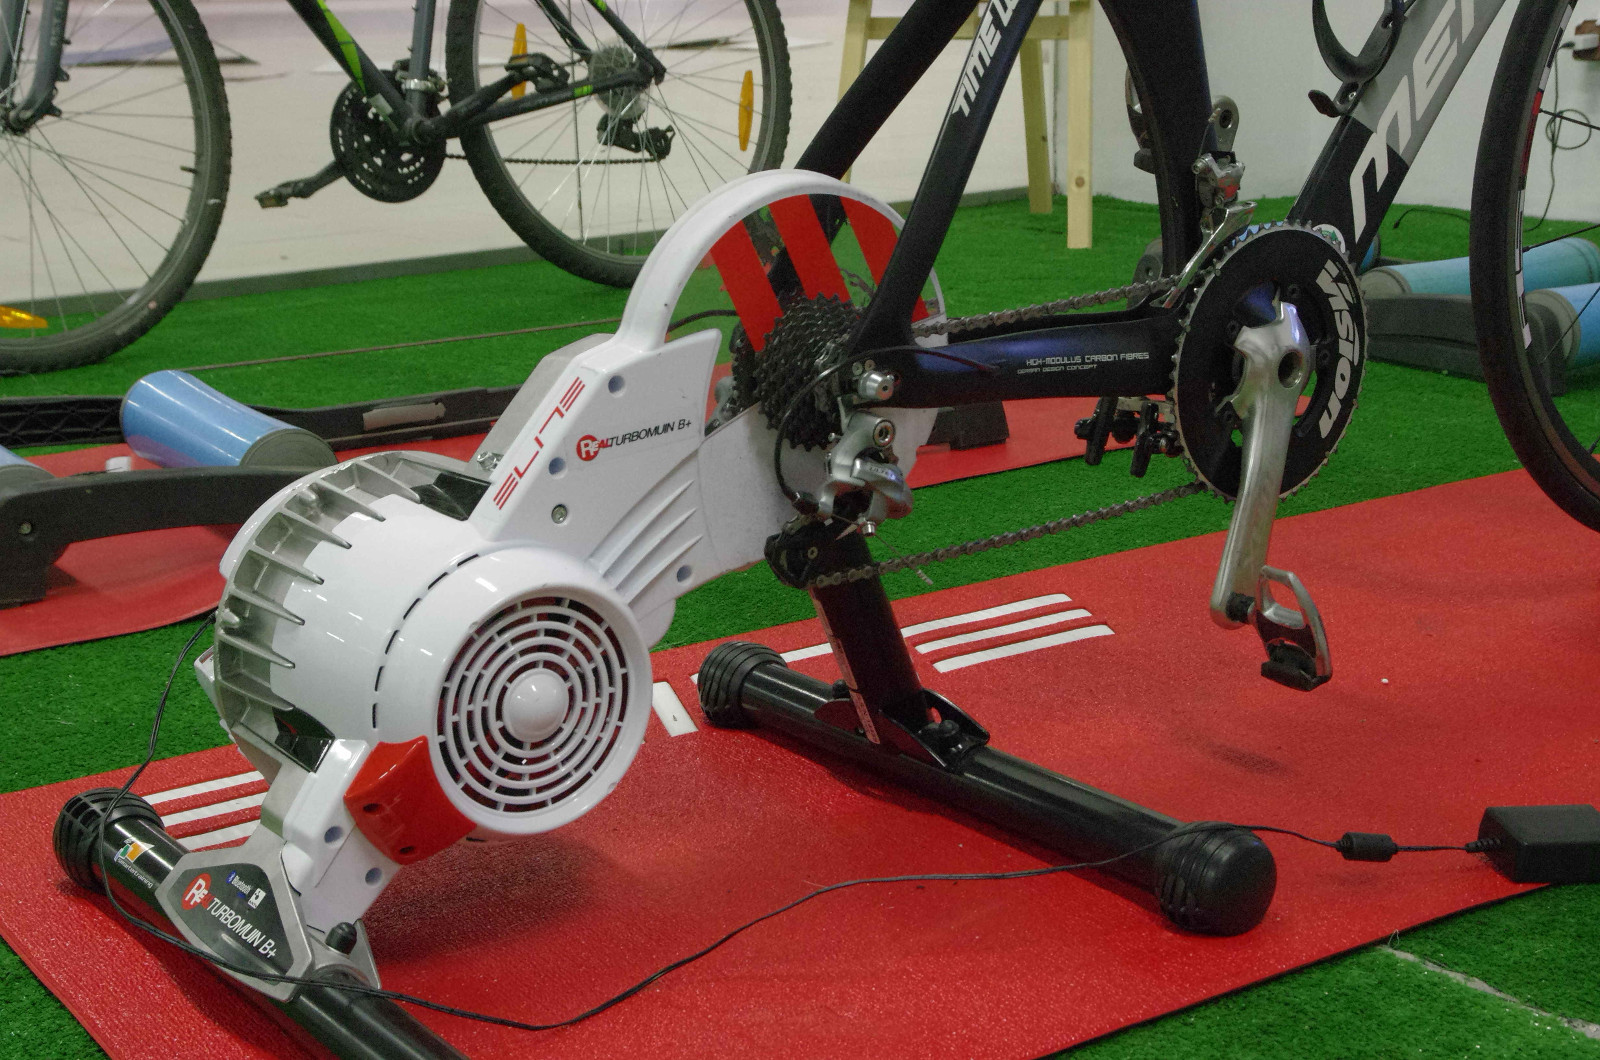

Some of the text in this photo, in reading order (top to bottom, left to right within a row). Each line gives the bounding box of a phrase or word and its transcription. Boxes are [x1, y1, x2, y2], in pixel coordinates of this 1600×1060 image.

[952, 10, 1002, 117] TIME
[1026, 352, 1150, 366] HIGH-MODULUS CARBON FIBRES
[1042, 365, 1065, 373] DESIGN
[1066, 363, 1098, 371] CONCEPT
[677, 418, 692, 431] B+
[492, 376, 586, 510] ELITE
[258, 938, 277, 959] B+
